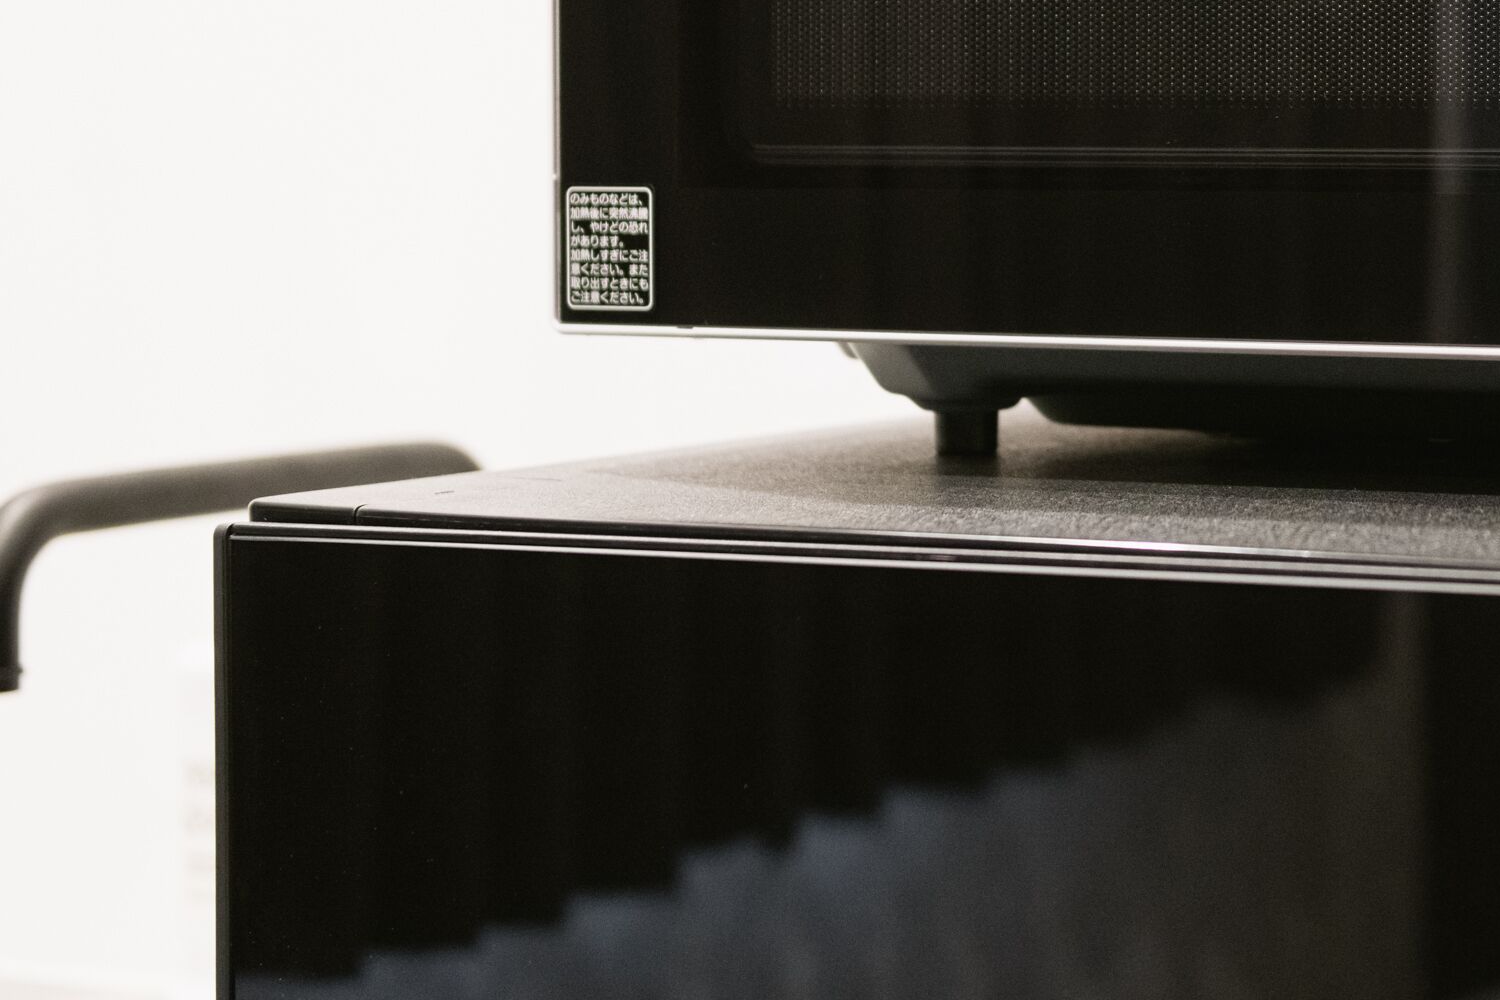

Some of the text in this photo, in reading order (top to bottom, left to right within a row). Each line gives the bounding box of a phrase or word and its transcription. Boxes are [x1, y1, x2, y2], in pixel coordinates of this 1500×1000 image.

[570, 193, 643, 206] のみものなどは、
[570, 235, 625, 248] があります。
